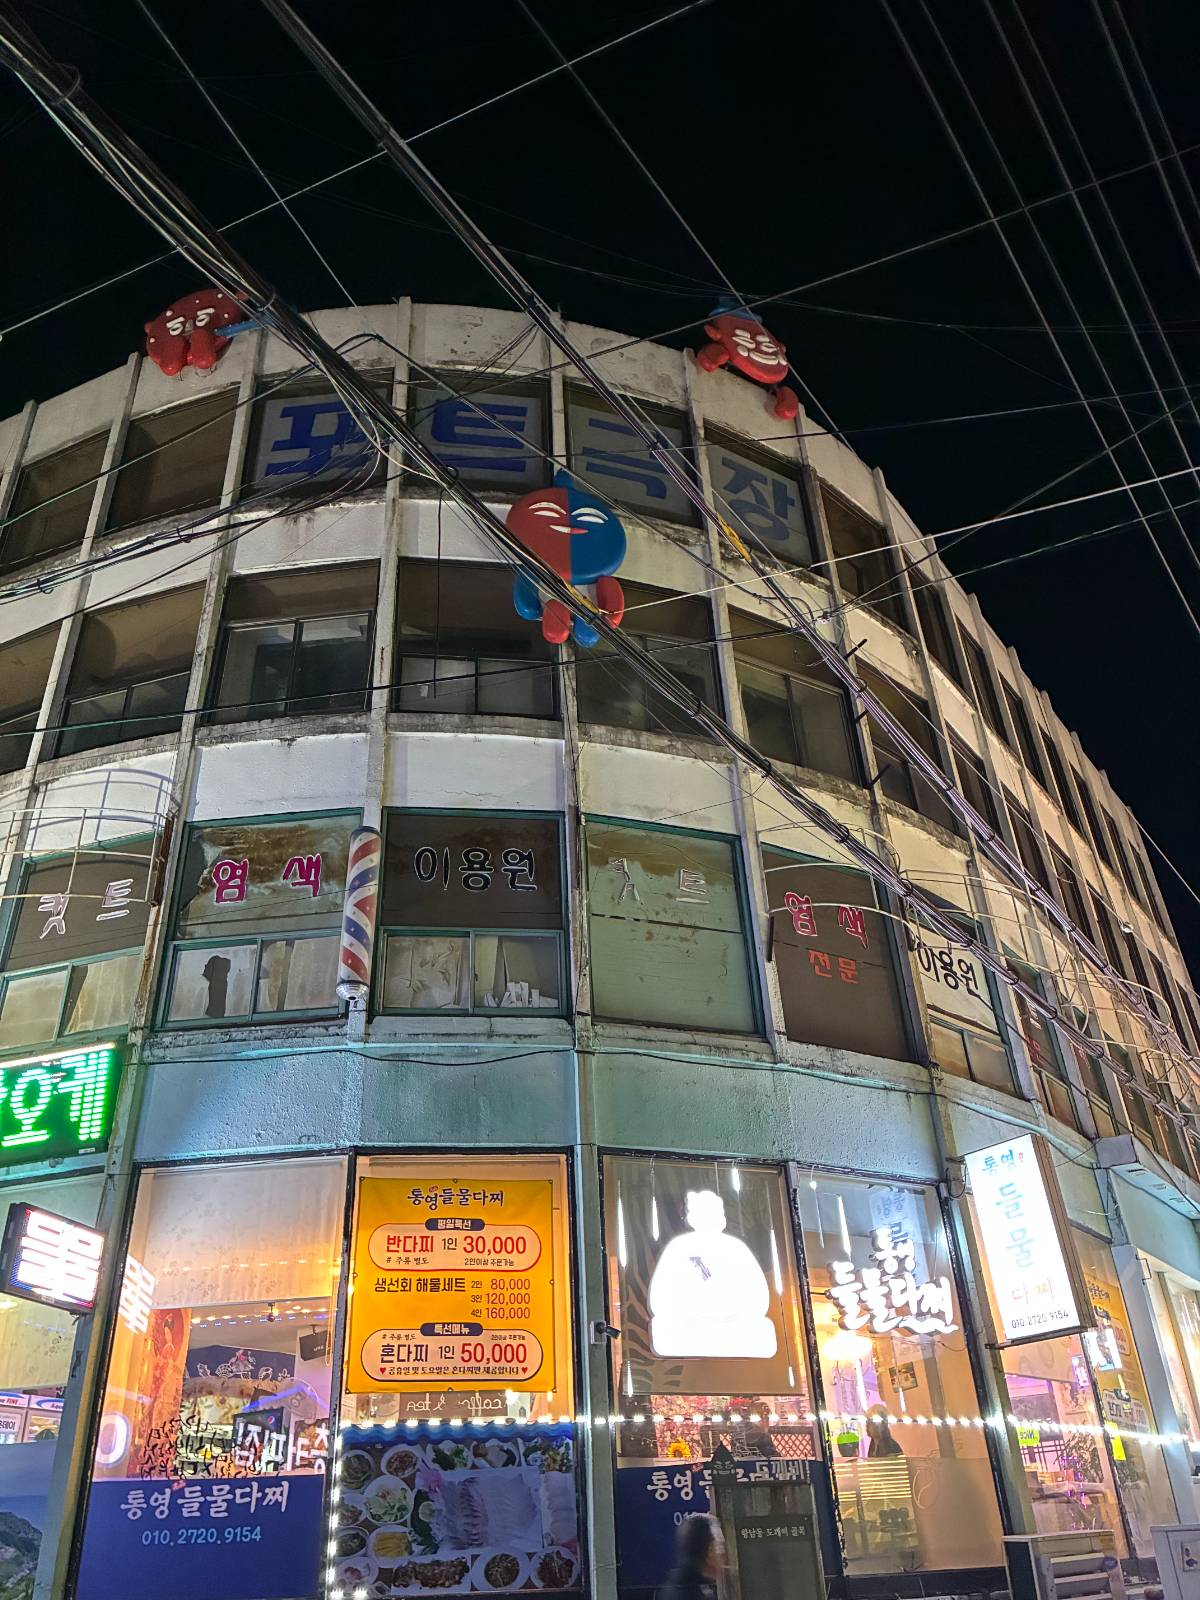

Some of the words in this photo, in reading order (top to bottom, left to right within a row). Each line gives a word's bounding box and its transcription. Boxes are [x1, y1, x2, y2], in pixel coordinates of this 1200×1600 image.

[414, 847, 537, 892] 이용원
[809, 950, 859, 984] 전문
[917, 941, 980, 998] 이용원
[982, 1150, 1016, 1176] 통영
[442, 1237, 458, 1251] 1인
[463, 1235, 527, 1256] 30,000
[374, 1277, 412, 1293] 생선회
[416, 1277, 466, 1293] 해물세트
[471, 1280, 483, 1289] 2인
[490, 1278, 530, 1292] 80,000
[471, 1295, 482, 1303] 3인
[486, 1292, 530, 1306] 120,000
[470, 1308, 482, 1317] 4인
[486, 1307, 530, 1320] 160,000
[438, 1345, 455, 1360] 1인
[461, 1343, 527, 1364] 50,000
[646, 1469, 694, 1501] 통영
[120, 1487, 171, 1521] 통영
[177, 1480, 290, 1519] 들물다찌
[141, 1526, 262, 1547] 010.2720.9154
